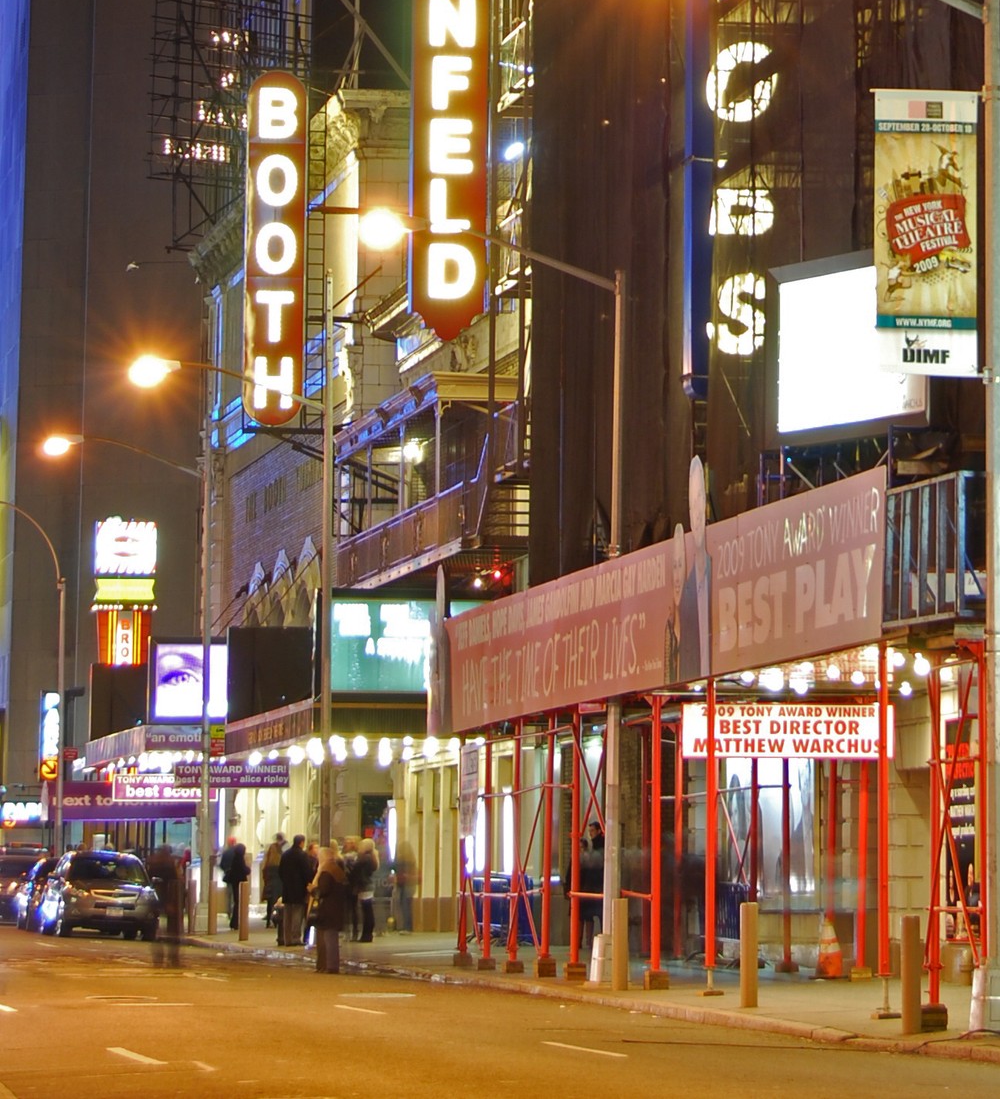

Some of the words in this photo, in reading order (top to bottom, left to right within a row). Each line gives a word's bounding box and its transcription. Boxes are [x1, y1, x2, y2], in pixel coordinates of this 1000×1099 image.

[878, 122, 920, 132] SEPTEMBER
[903, 203, 922, 217] NEW
[922, 200, 943, 213] YORK
[895, 209, 959, 234] MUSICAL
[892, 221, 963, 250] THEATRE
[920, 235, 959, 252] FESTIVAL
[253, 87, 298, 410] BOOTH
[913, 257, 940, 274] 2009
[895, 317, 952, 327] WWW.NYMF.ORG
[902, 348, 950, 364] DIMF
[717, 537, 745, 579] 2009
[747, 521, 779, 568] TONY
[783, 506, 826, 559] AWARD
[829, 487, 880, 546] WINNER
[719, 570, 787, 652] BEST
[795, 544, 876, 633] PLAY
[462, 655, 488, 716] HAVE
[491, 647, 512, 706] THE
[515, 640, 541, 702] TIME
[543, 632, 560, 697] OF
[562, 619, 599, 690] THEIR
[701, 706, 735, 717] 209
[739, 706, 773, 717] TONY
[778, 706, 822, 717] AWARD
[826, 706, 875, 717] WINNER
[719, 719, 762, 734] BEST
[770, 719, 860, 735] DIRECTOR
[693, 738, 785, 753] MATTHEW
[209, 765, 243, 774] AWARD
[245, 765, 287, 774] WINNER!
[117, 776, 142, 784] TONY
[142, 776, 175, 784] AWARD
[175, 775, 195, 783] best
[239, 775, 261, 783] alice
[263, 775, 289, 784] ripley
[126, 785, 159, 798] best
[95, 794, 114, 806] to
